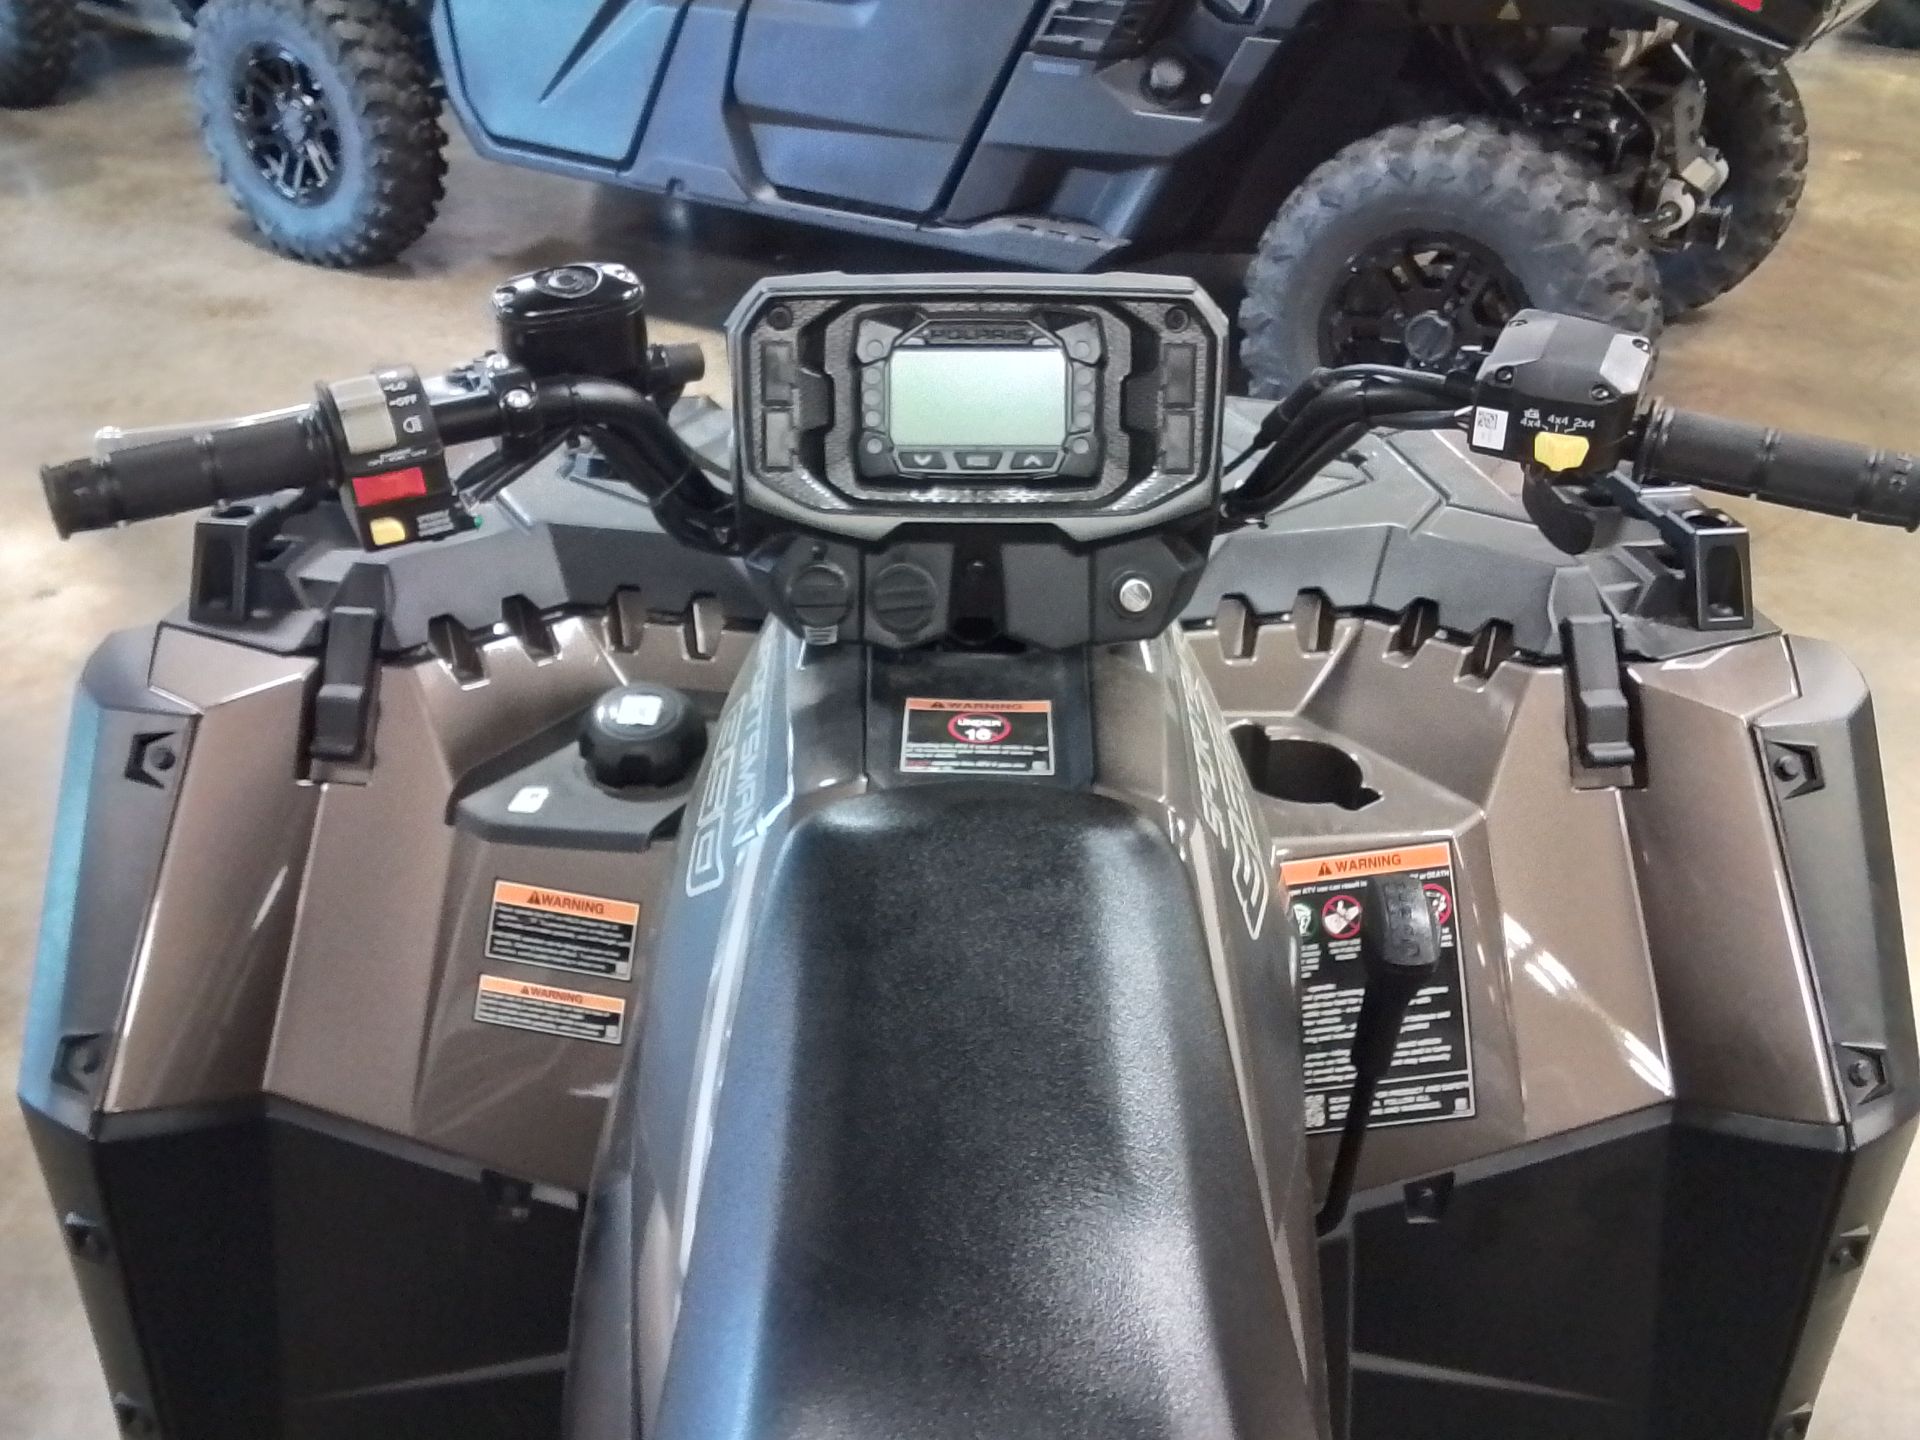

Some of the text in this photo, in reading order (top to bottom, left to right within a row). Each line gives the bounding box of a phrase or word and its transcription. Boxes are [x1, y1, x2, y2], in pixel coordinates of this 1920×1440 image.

[1520, 417, 1541, 428] 4x4
[1548, 414, 1569, 425] 4x4
[1574, 418, 1595, 429] 2x4
[948, 702, 1022, 710] WARNING
[957, 718, 1002, 727] UNDER
[1335, 854, 1402, 873] WARNING
[541, 893, 604, 914] WARNING
[530, 986, 584, 1004] WARNING
